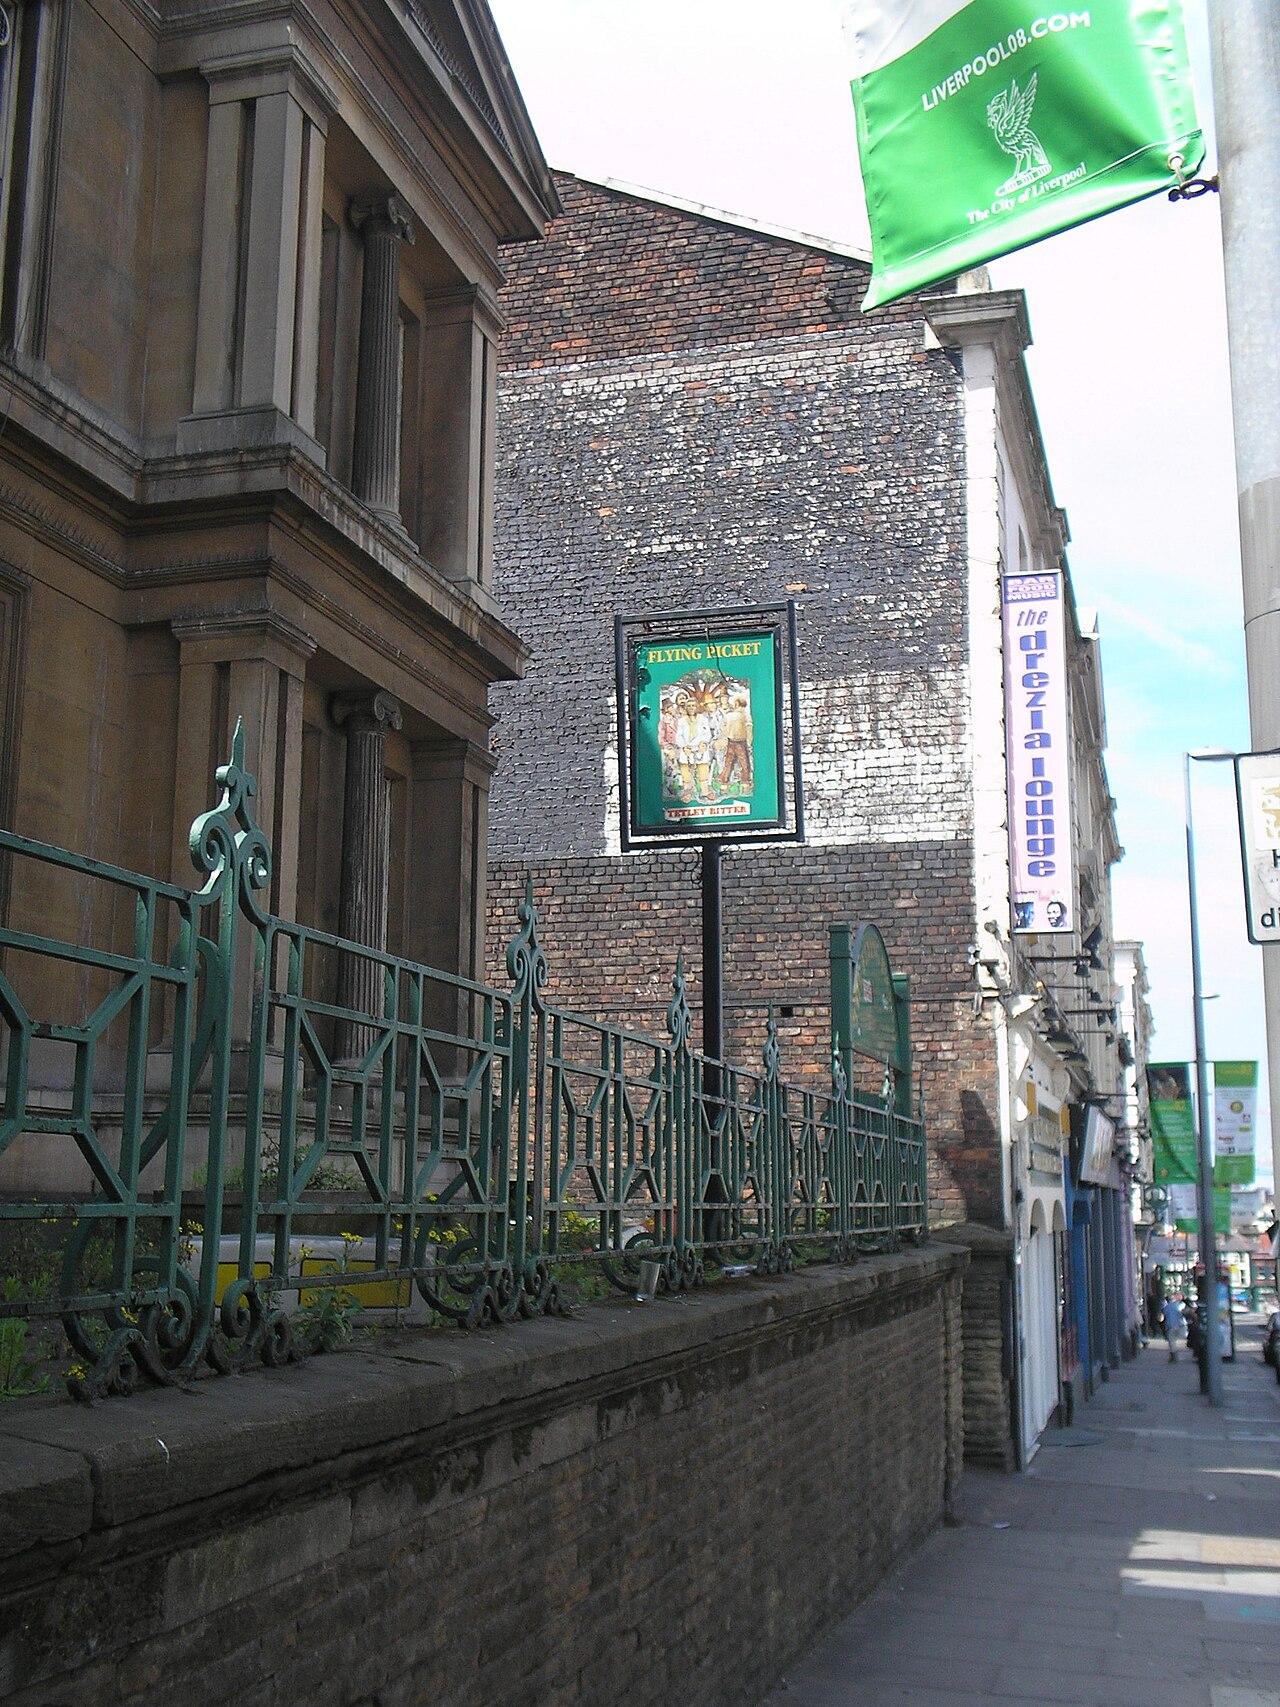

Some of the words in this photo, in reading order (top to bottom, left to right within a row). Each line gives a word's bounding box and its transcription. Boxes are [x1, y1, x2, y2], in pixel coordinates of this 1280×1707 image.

[921, 11, 1091, 112] LIVERPOOL08.COM
[967, 208, 990, 224] The
[991, 199, 1016, 215] City
[1018, 187, 1032, 203] of
[1033, 161, 1087, 198] Liverpool
[1007, 591, 1057, 600] MUSIC
[1017, 609, 1048, 626] the
[648, 648, 702, 663] FLYING
[706, 643, 761, 659] PICKET
[667, 808, 706, 818] TETLEY
[710, 806, 747, 815] BITTER
